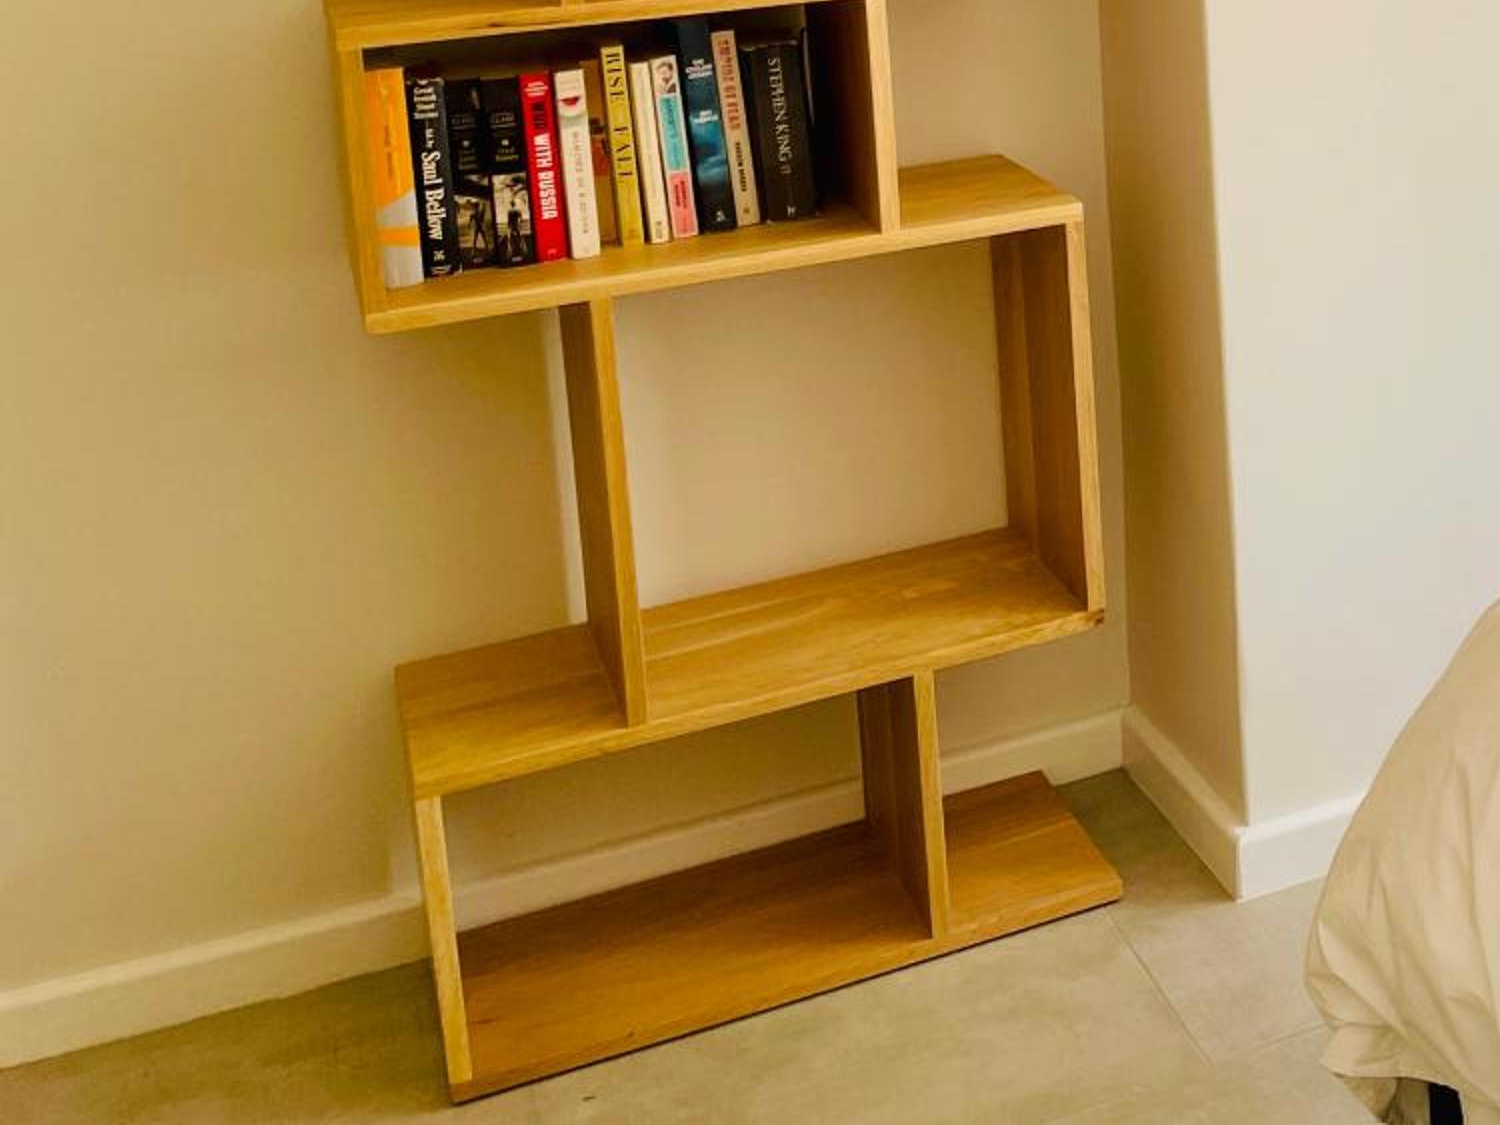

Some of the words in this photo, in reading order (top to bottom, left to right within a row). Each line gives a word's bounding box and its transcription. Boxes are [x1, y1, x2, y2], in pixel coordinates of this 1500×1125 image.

[605, 52, 625, 102] RISE
[767, 58, 787, 121] STEPHEN
[533, 133, 553, 169] WITH
[613, 125, 633, 183] FALL
[774, 124, 793, 162] KING
[421, 151, 443, 186] Saul
[425, 186, 447, 241] Bellow
[537, 170, 558, 220] RUSSIA
